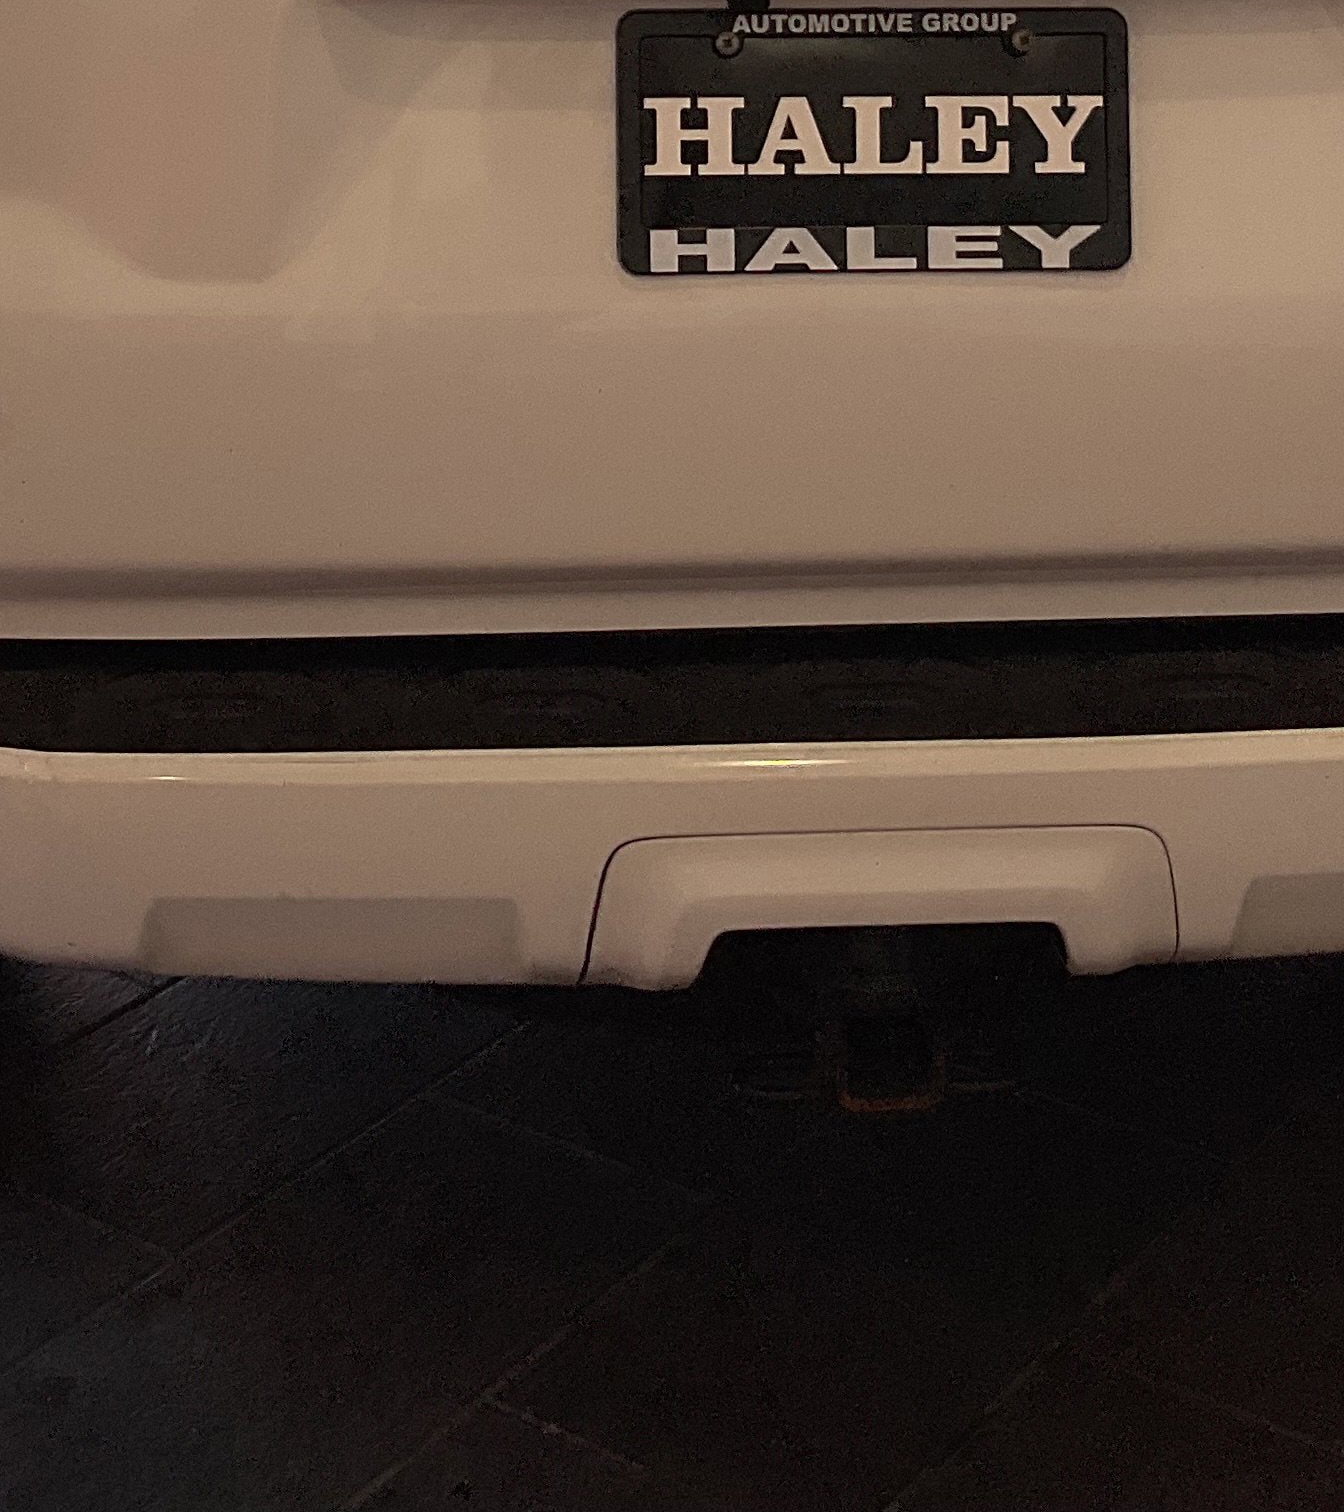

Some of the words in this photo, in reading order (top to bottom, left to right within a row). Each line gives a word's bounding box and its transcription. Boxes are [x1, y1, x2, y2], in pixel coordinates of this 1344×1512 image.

[731, 13, 914, 35] AUTOMOTIVE
[921, 11, 1017, 33] GROUP
[642, 95, 1105, 176] HALEY
[648, 224, 1103, 274] HALEY
